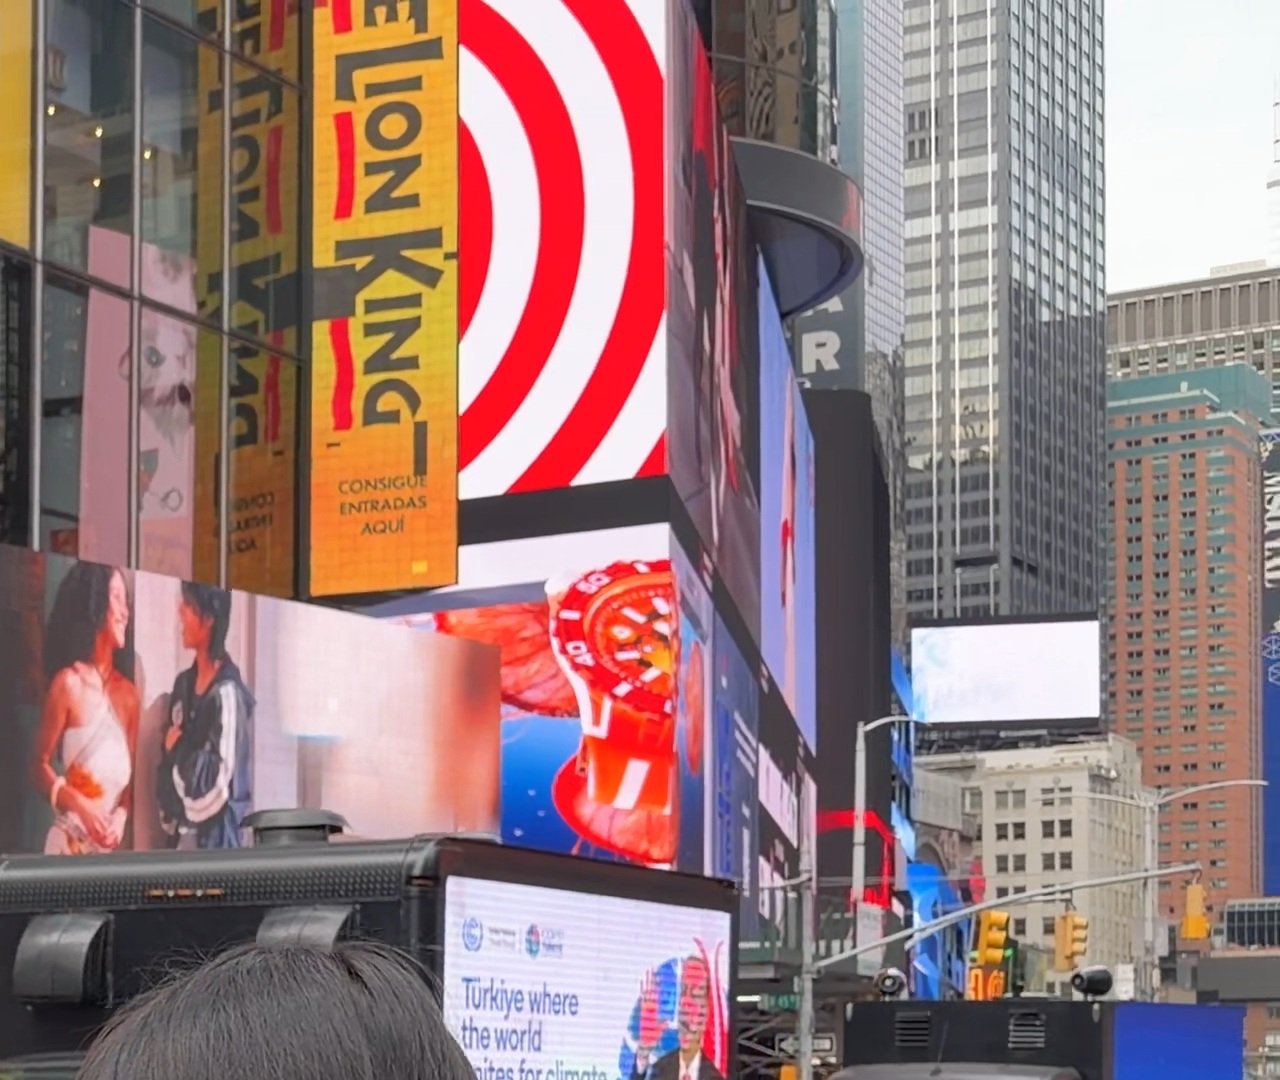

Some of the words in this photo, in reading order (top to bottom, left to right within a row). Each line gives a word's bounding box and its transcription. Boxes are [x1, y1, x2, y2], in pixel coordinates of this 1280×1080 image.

[334, 35, 444, 215] LION
[334, 226, 445, 476] KING
[338, 474, 429, 495] CONSIGUE
[339, 496, 428, 516] ENTRADAS
[360, 514, 405, 536] AQUÍ
[461, 976, 525, 1021] Türkiye
[528, 981, 579, 1016] where
[460, 1016, 491, 1051] the
[494, 1019, 543, 1052] world
